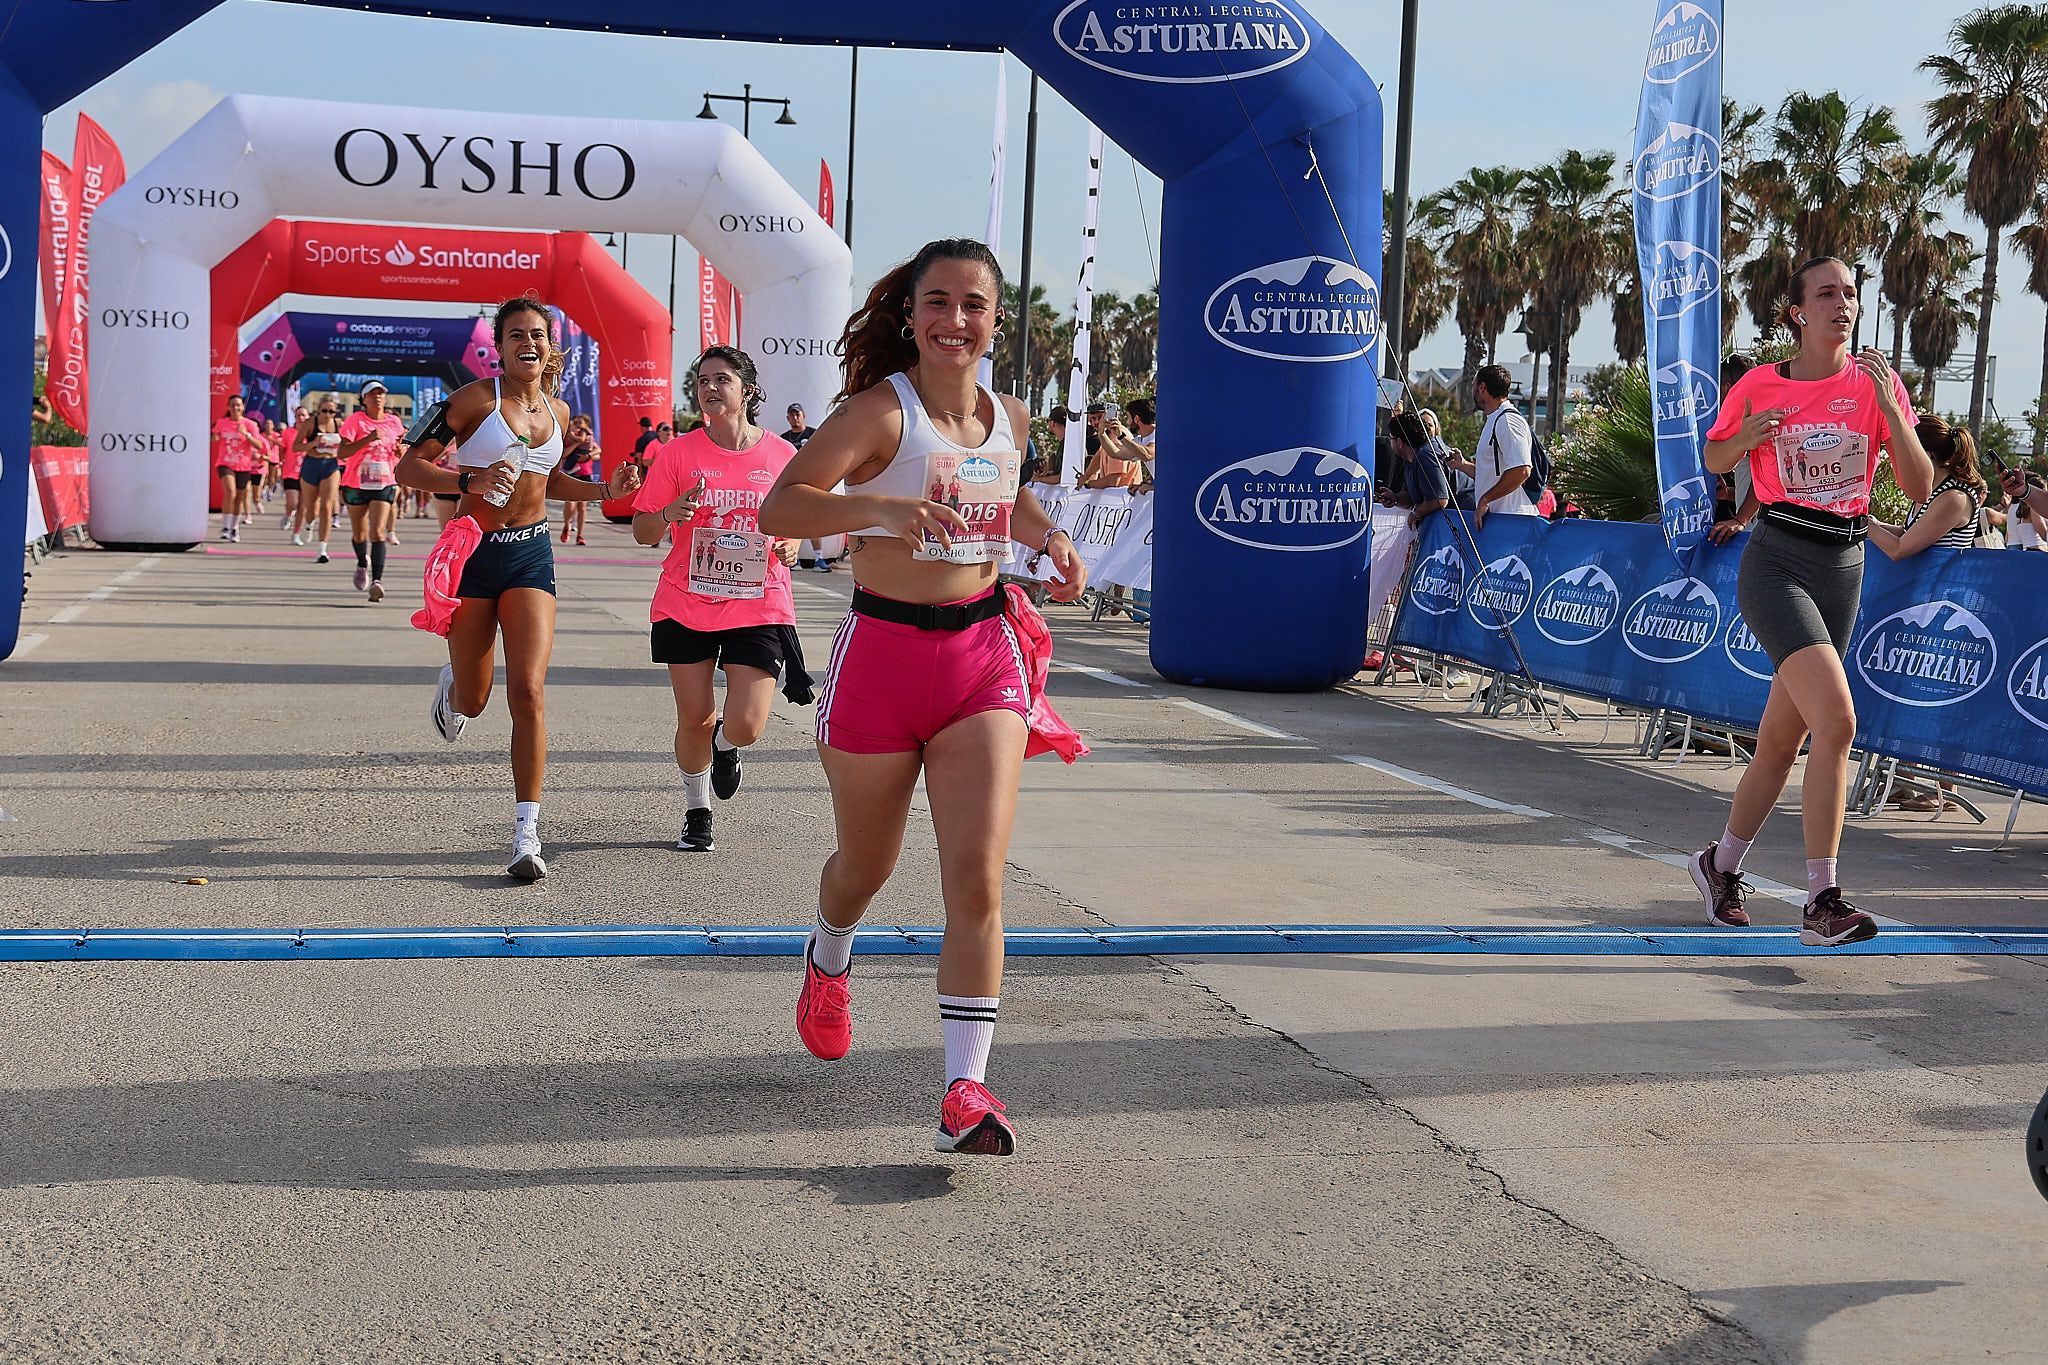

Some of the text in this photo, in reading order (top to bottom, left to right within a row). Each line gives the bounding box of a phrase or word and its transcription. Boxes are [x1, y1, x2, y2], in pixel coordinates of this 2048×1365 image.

[1116, 6, 1283, 19] CENTRAL LECHERA
[1075, 11, 1299, 53] ASTURIANA
[334, 128, 637, 201] OYSHO
[145, 186, 240, 210] OYSHO
[719, 214, 804, 234] OYSHO
[304, 239, 542, 270] Sports Santander
[380, 275, 460, 286] sportssantander.es
[1254, 292, 1324, 303] CENTRAL
[102, 309, 190, 330] OYSHO
[1218, 293, 1376, 335] ASTURIANA
[623, 359, 656, 371] Sports
[620, 376, 668, 387] Santander
[101, 432, 188, 454] OYSHO
[1806, 439, 1839, 449] ASTURIANA
[936, 461, 956, 469] SUMA
[960, 467, 997, 477] ASTURIANA
[1809, 461, 1842, 478] 016
[1244, 482, 1367, 493] CENTRAL LECHERA
[1818, 477, 1835, 485] 4523
[959, 503, 998, 521] 016
[1209, 483, 1368, 524] ASTURIANA
[489, 521, 550, 543] NIKE PR
[928, 547, 966, 558] OYSHO
[714, 560, 743, 573] 016
[696, 584, 720, 593] OYSHO
[1537, 588, 1609, 628] ASTURIANA
[1651, 602, 1713, 618] CENTRAL LECHERA
[1626, 603, 1709, 644] ASTURIANA
[1894, 632, 1986, 655] CENTRAL LECHERA
[1863, 631, 1981, 687] ASTURIANA
